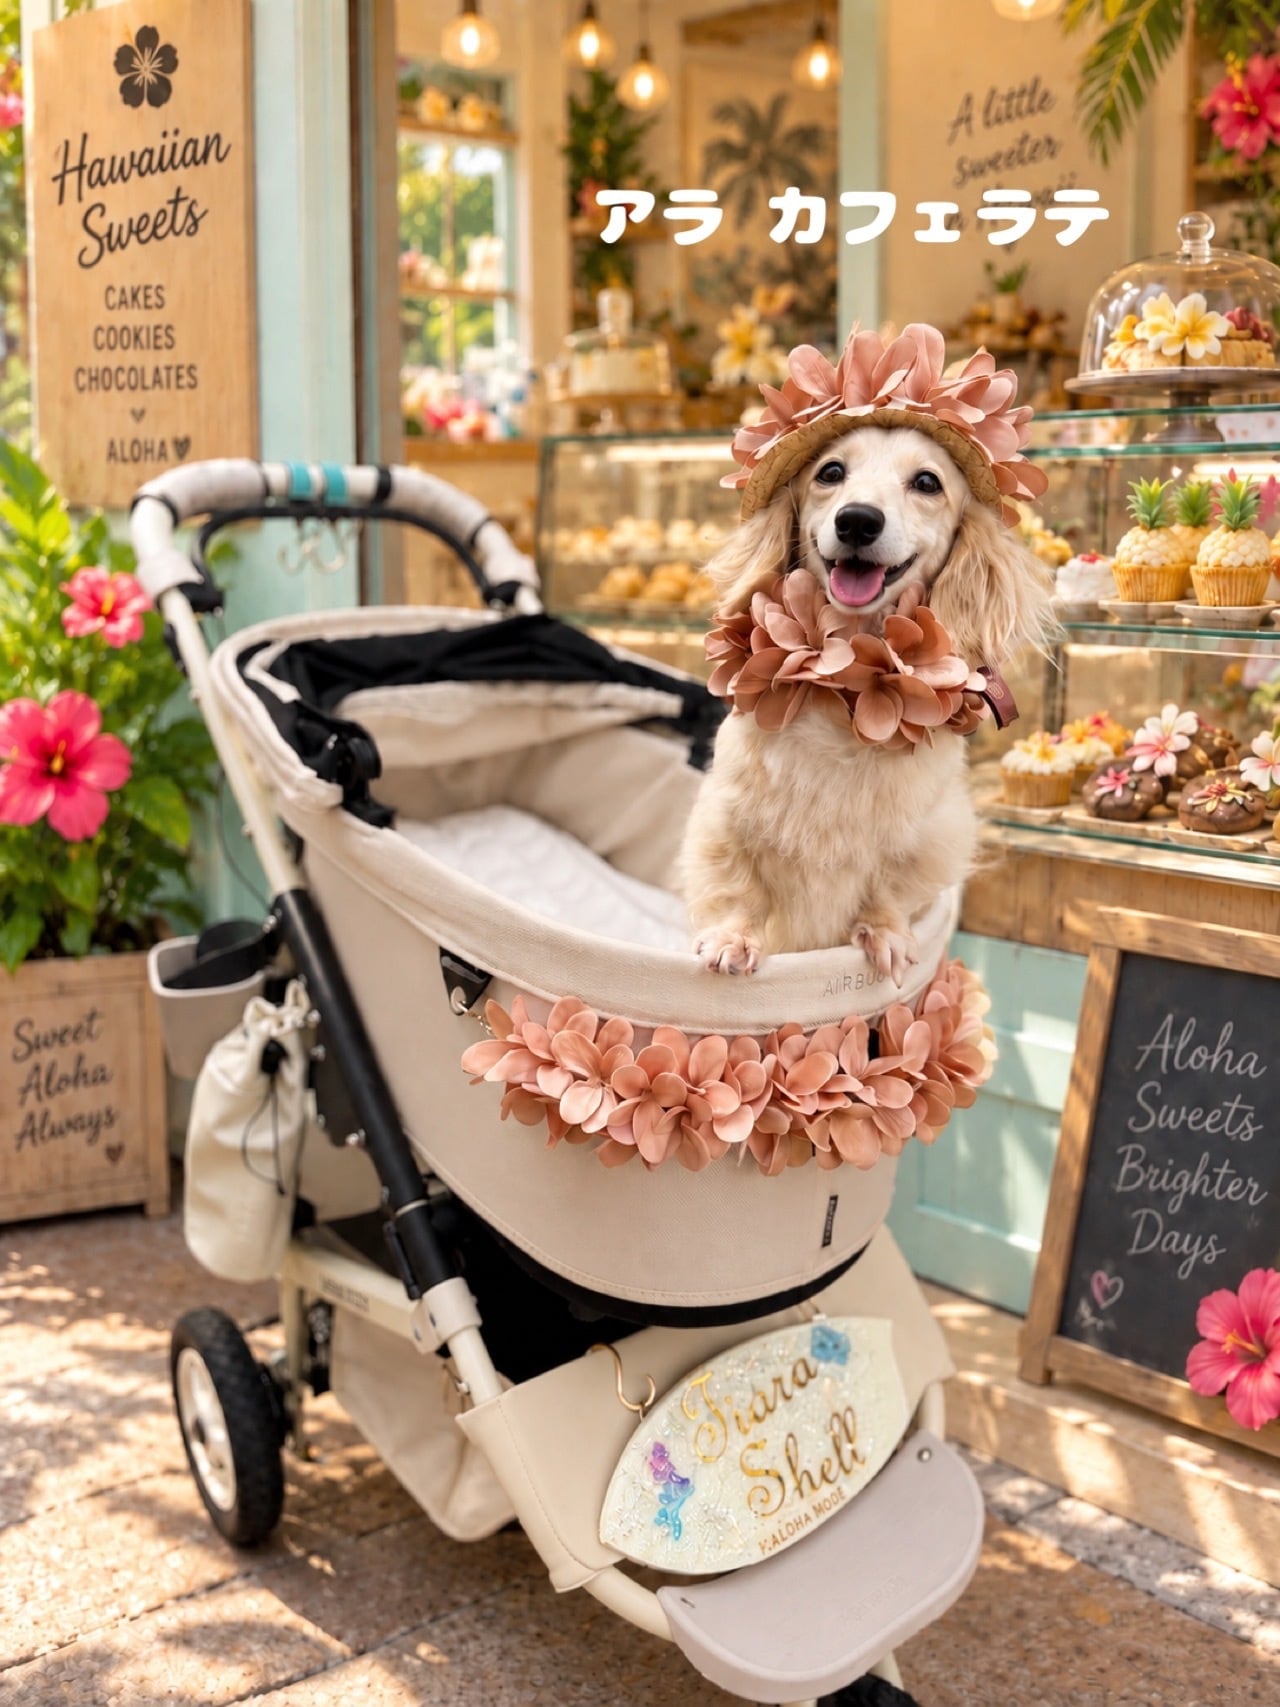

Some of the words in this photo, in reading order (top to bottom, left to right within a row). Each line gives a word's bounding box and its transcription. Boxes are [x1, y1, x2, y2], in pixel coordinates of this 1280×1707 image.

[947, 92, 974, 146] A
[982, 74, 1056, 128] little
[51, 128, 232, 205] Hawaiian
[78, 186, 208, 269] Sweets
[104, 284, 166, 311] CAKES
[93, 324, 175, 351] COOKIES
[74, 364, 198, 393] CHOCOLATES
[107, 436, 168, 463] ALOHA
[12, 1007, 104, 1062] Sweet
[1135, 1012, 1267, 1079] Aloha
[18, 1052, 113, 1107] Aloha
[1128, 1080, 1263, 1142] Sweets
[15, 1105, 120, 1152] Always
[1111, 1143, 1268, 1215] Brighter
[1127, 1207, 1226, 1280] Days
[680, 1357, 818, 1464] Tiara
[739, 1405, 866, 1517] Shell
